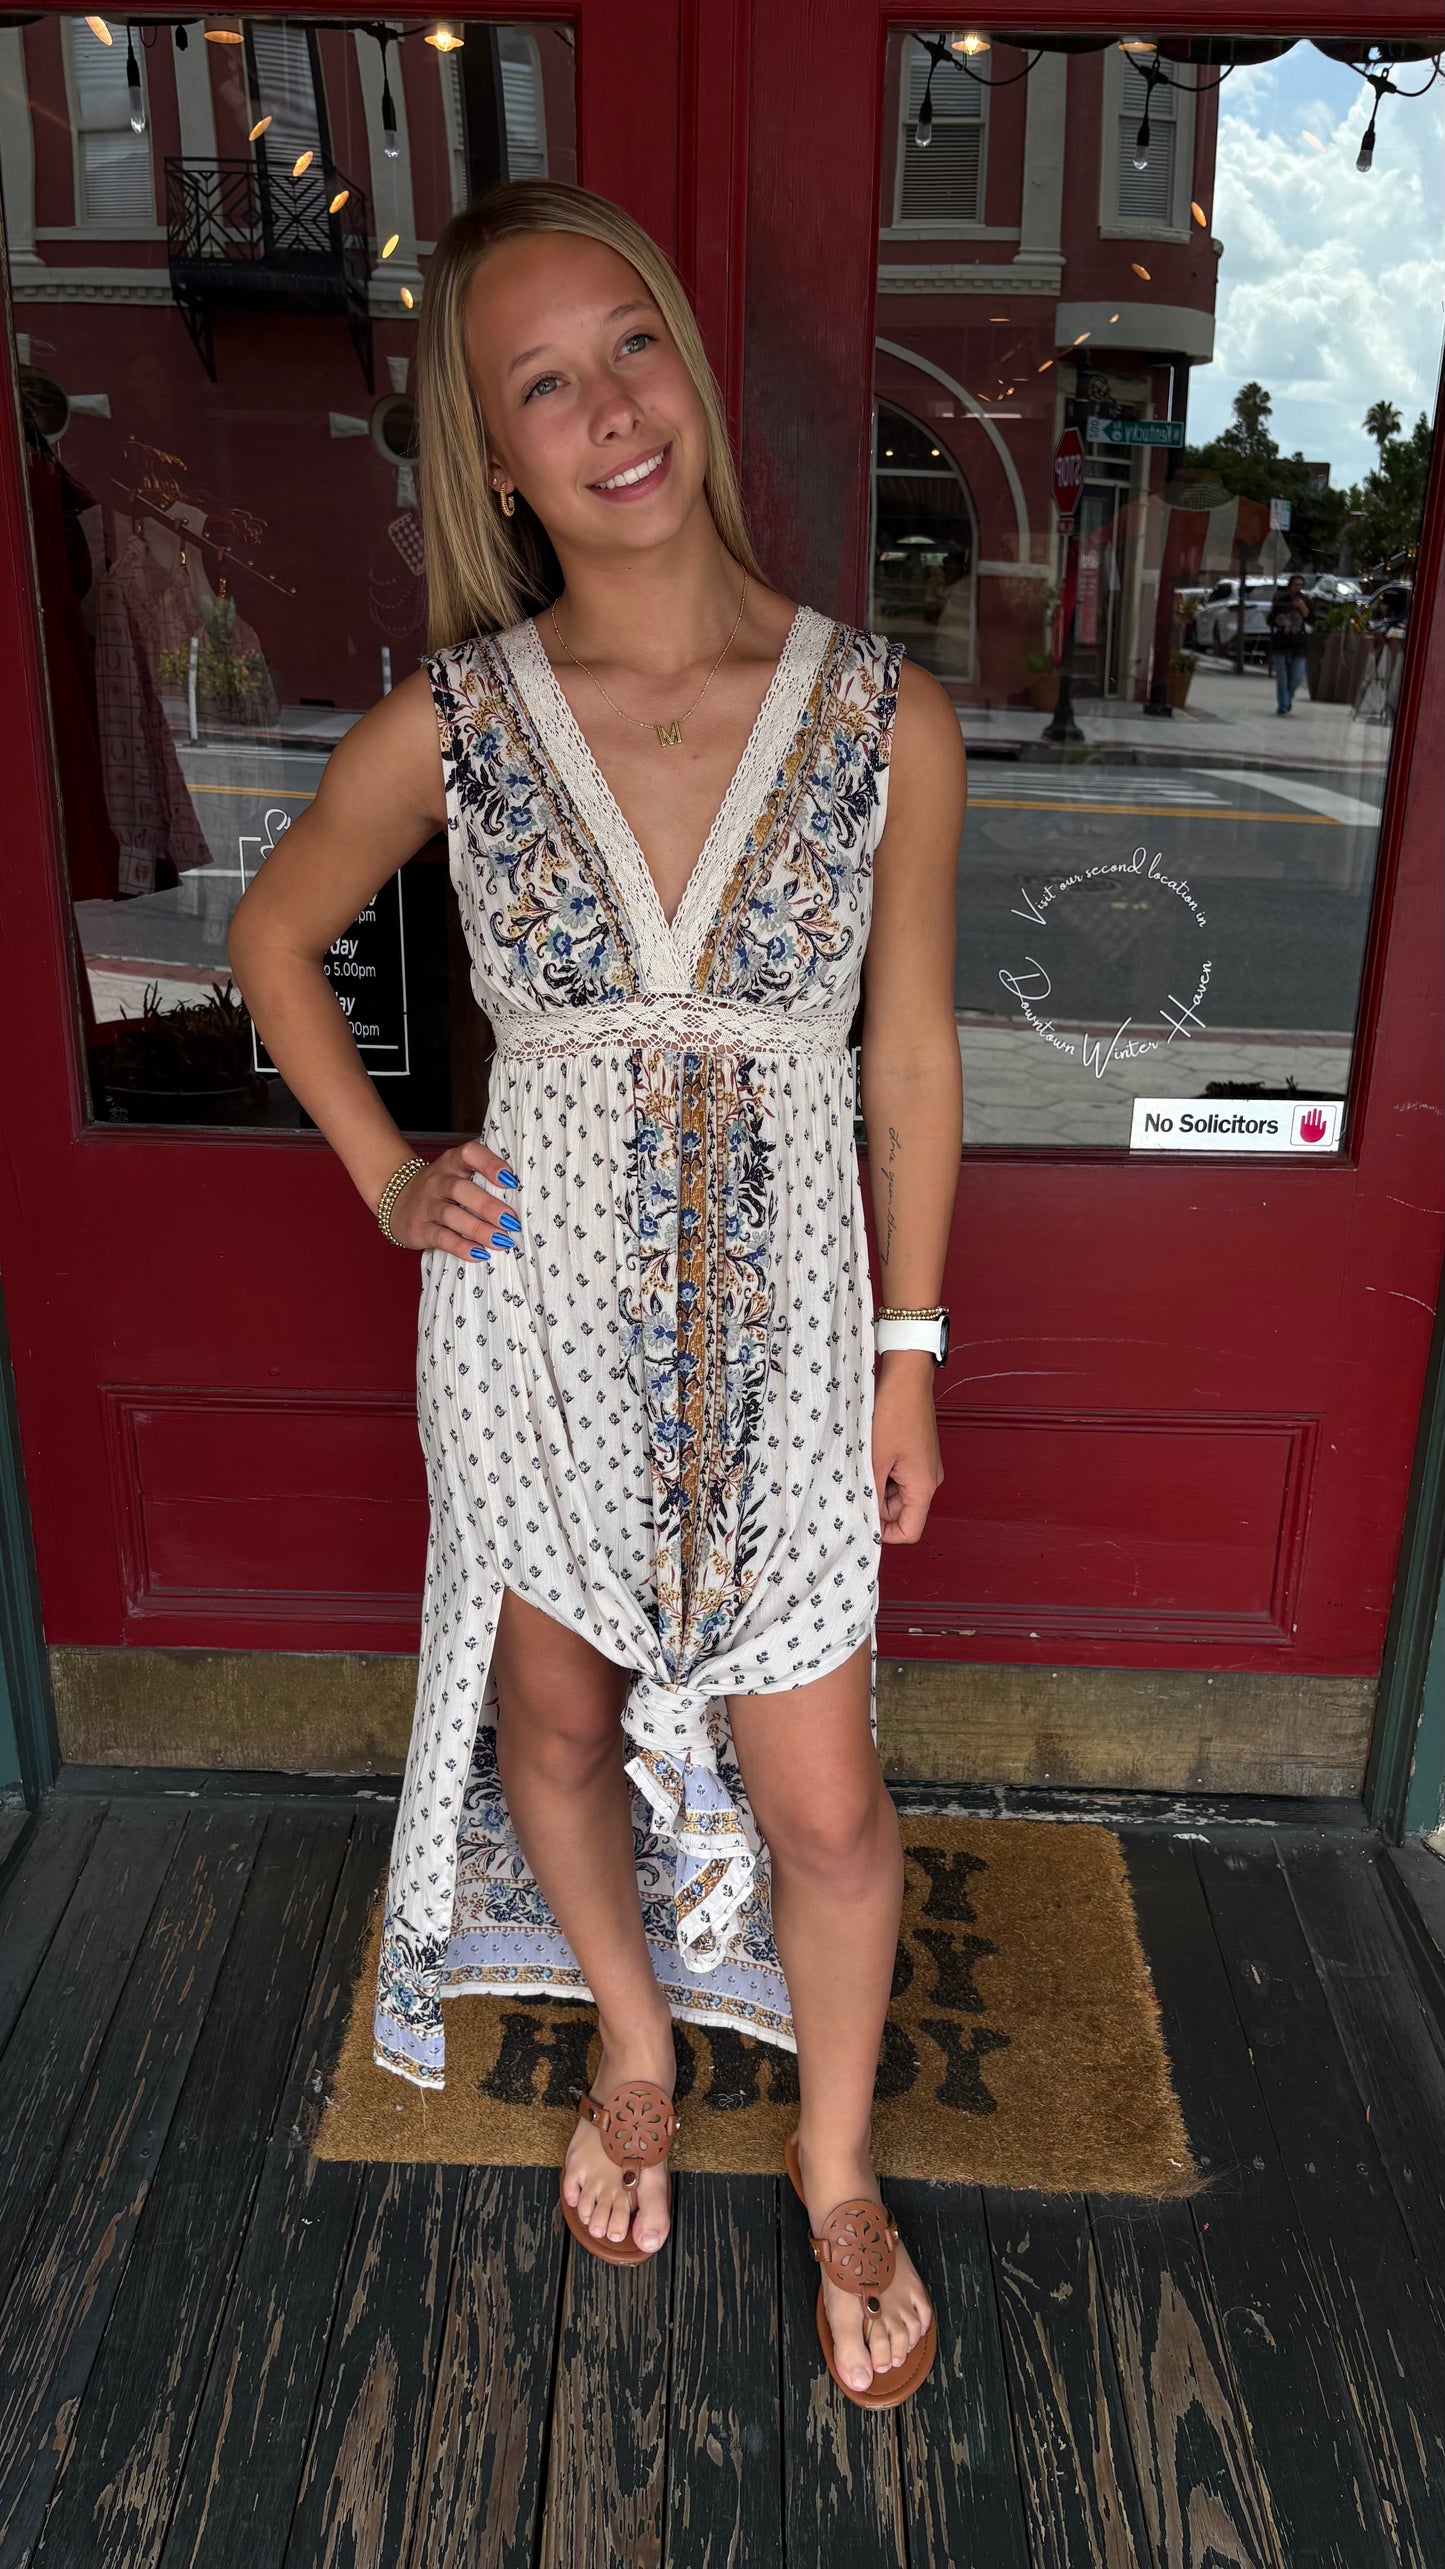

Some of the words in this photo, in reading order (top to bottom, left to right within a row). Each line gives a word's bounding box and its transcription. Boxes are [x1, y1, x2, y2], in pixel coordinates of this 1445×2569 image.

[1011, 884, 1057, 926] Visit
[1058, 874, 1083, 891] our
[1085, 847, 1147, 879] second
[1148, 852, 1198, 911] location
[1195, 911, 1208, 928] in
[333, 961, 377, 979] 5.00pm
[999, 956, 1075, 1056] Downtown
[1083, 1017, 1159, 1079] Winter
[1160, 960, 1214, 1044] Haven
[1145, 1114, 1174, 1133] No
[1179, 1113, 1279, 1135] Solicitors
